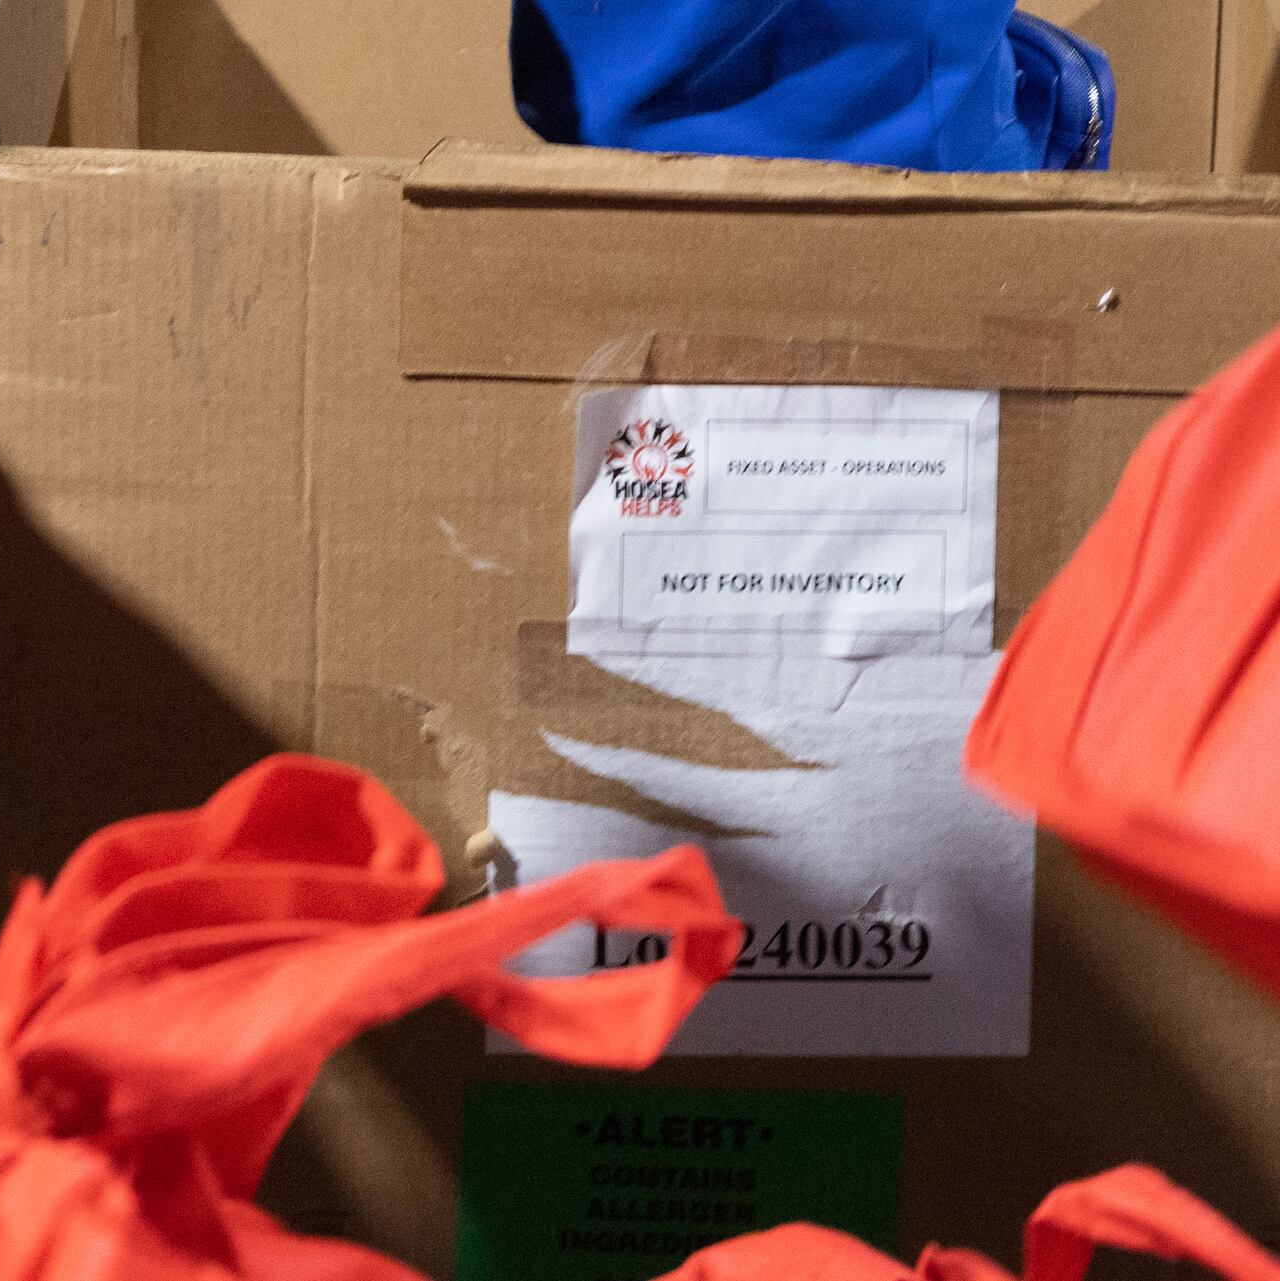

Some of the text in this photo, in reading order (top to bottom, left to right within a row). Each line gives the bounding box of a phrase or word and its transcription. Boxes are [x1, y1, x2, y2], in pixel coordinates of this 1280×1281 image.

[726, 459, 774, 476] FIXED
[777, 459, 828, 476] ASSET
[841, 459, 946, 476] OPERATIONS
[614, 477, 688, 501] HOSEA
[619, 499, 683, 518] HELPS
[661, 572, 905, 594] NOT FOR INVENTORY
[592, 916, 931, 970] Lo 240039
[587, 1163, 757, 1191] CONTAINS
[584, 1197, 758, 1223] ALLERGEN
